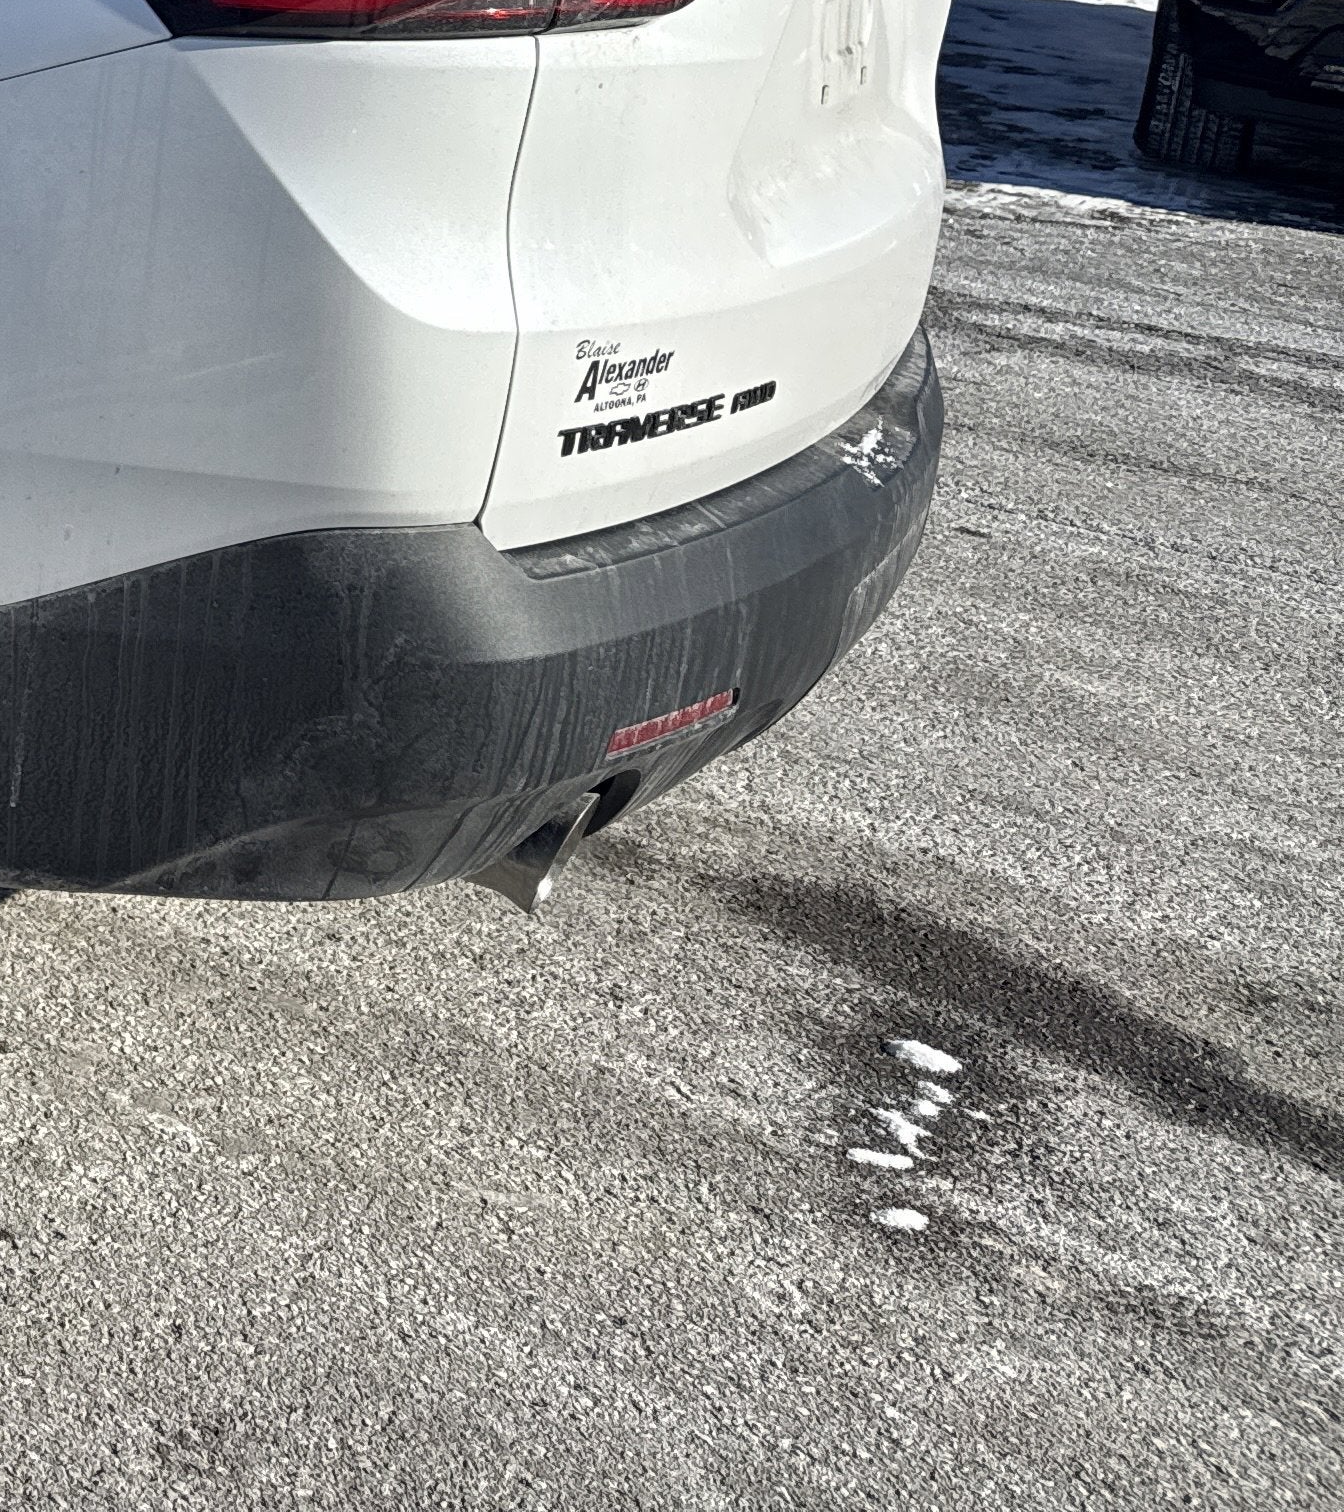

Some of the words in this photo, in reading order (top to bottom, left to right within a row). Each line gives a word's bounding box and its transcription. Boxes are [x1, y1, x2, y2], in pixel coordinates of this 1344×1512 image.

[576, 339, 621, 360] Blaise
[574, 348, 675, 403] Alexander
[557, 393, 726, 458] TRAVERSE
[730, 380, 777, 415] AWD
[594, 396, 634, 413] ALTOONA,
[635, 393, 646, 404] PA
